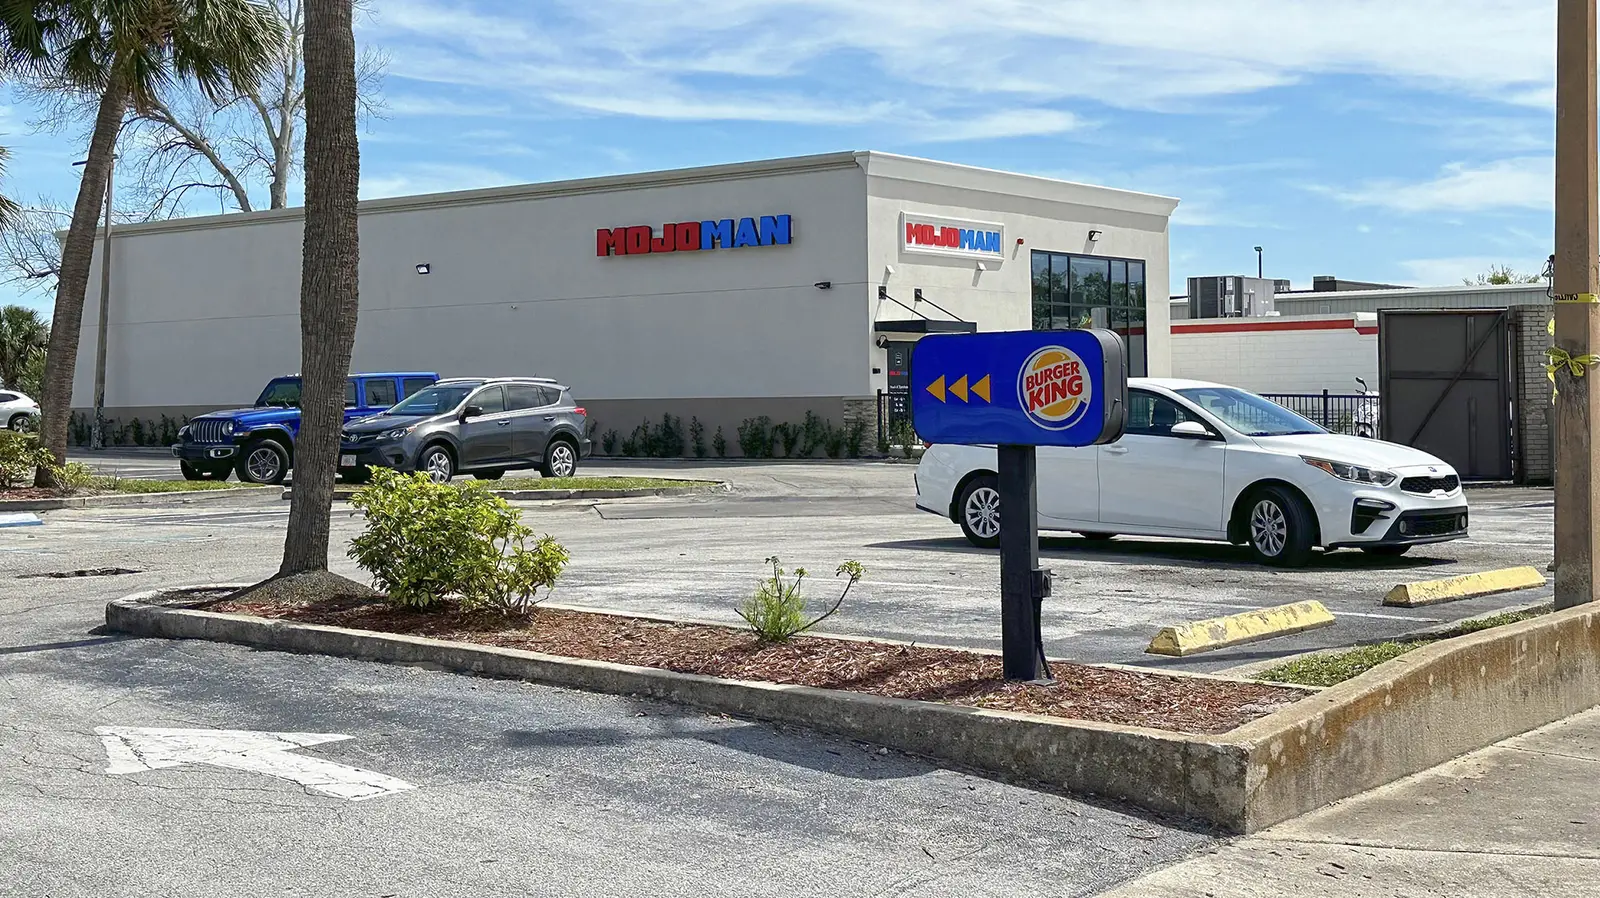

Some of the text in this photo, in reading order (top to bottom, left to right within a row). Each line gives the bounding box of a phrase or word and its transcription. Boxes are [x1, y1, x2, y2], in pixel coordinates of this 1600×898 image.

[597, 214, 792, 257] MOJOMAN
[905, 222, 1001, 252] MOJOMAN
[1026, 361, 1080, 392] BURGER
[1029, 375, 1083, 412] KING
